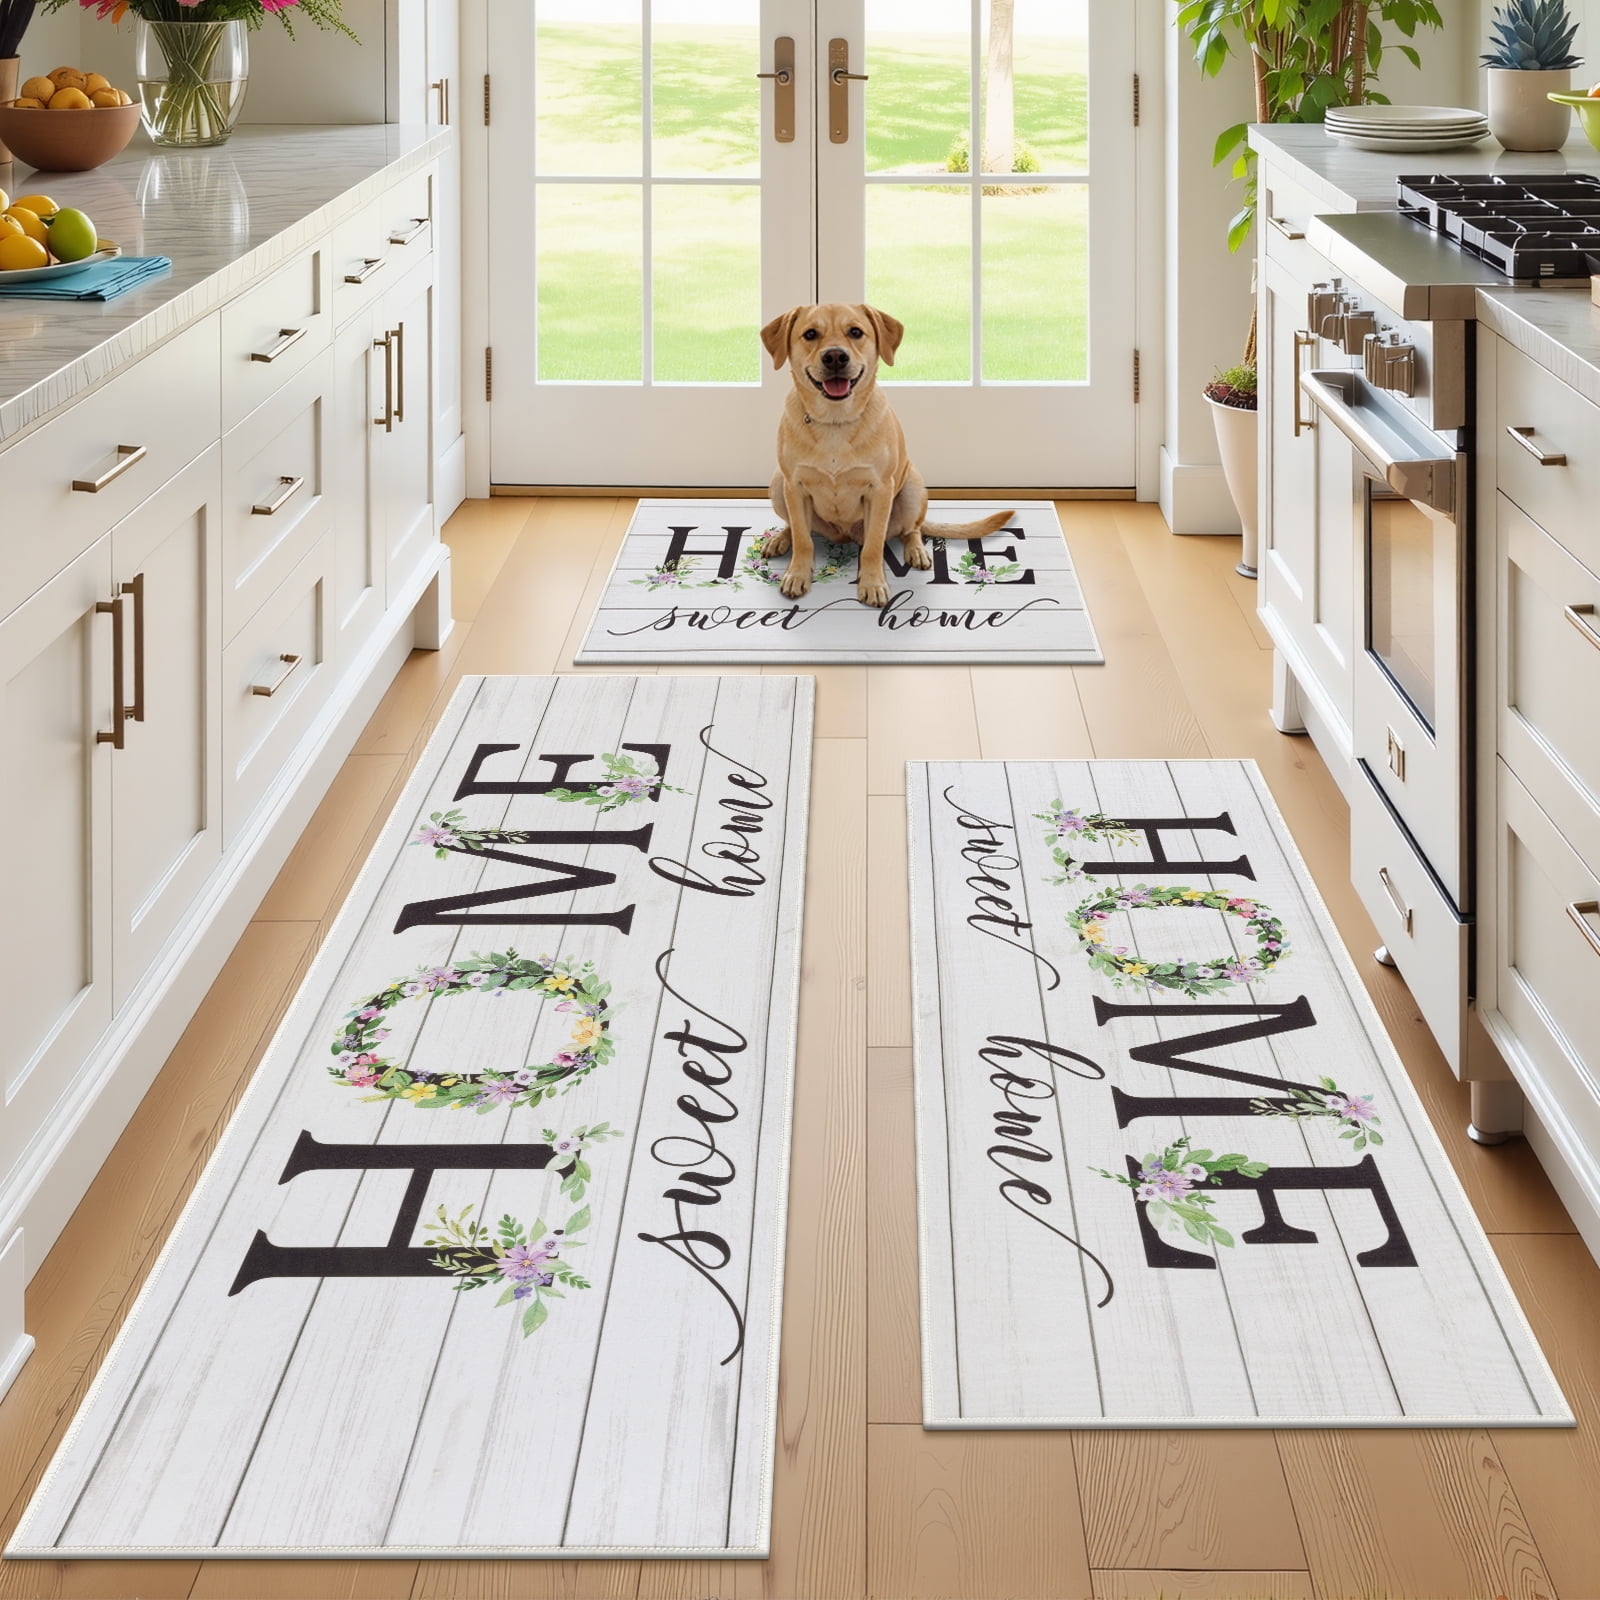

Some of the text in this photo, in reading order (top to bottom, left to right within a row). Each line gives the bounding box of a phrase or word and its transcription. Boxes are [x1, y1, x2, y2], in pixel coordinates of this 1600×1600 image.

[606, 589, 1061, 637] sweet home
[227, 743, 672, 1298] HOME
[637, 724, 775, 1366] sweet home
[942, 785, 1115, 1309] sweet home
[1048, 811, 1419, 1269] HOME
